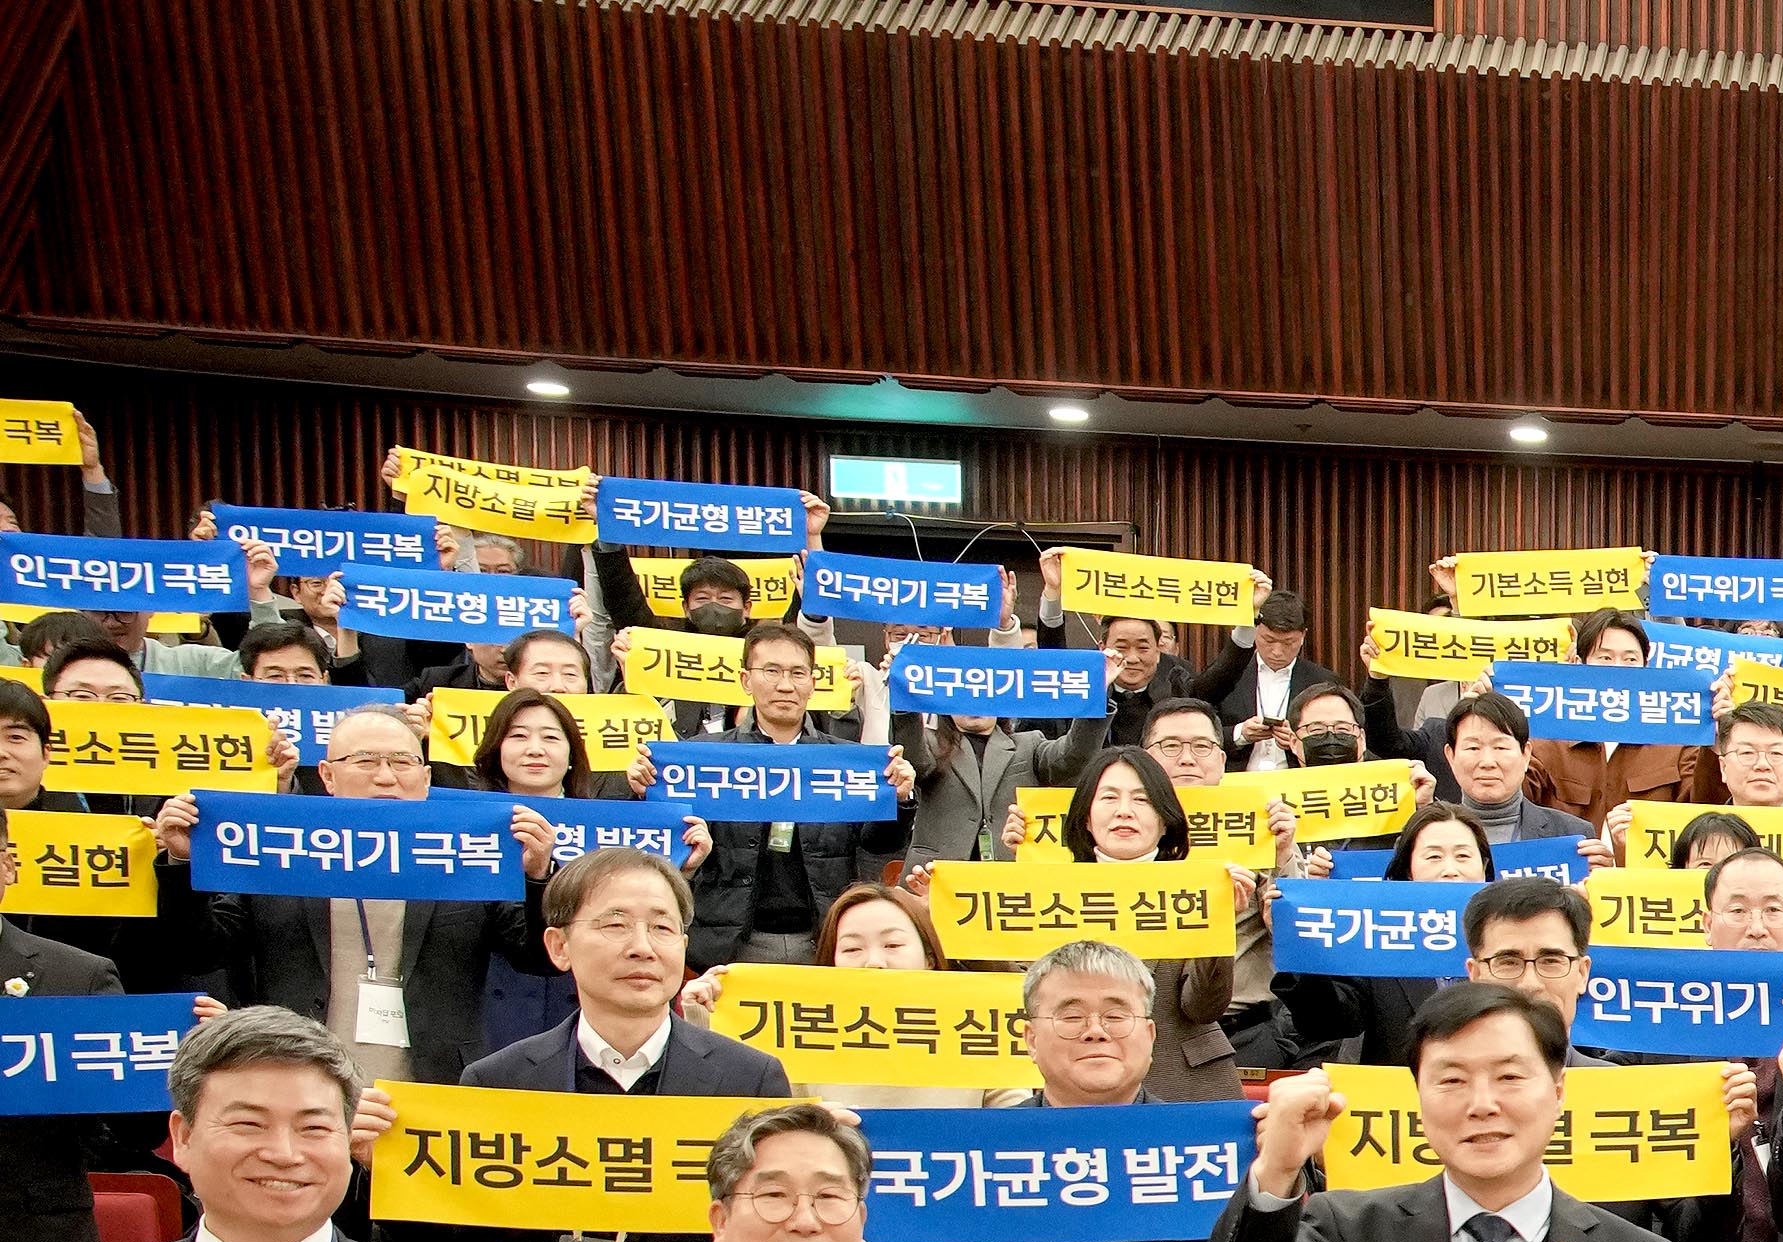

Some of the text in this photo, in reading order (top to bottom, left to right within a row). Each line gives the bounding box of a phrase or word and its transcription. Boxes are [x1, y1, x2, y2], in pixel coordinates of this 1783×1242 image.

[4, 419, 61, 447] 극복
[424, 473, 538, 523] 지방소멸
[613, 497, 793, 537] 국가균형 발전
[228, 523, 424, 563] 인구위기 극복
[10, 553, 232, 594] 인구위기 극복
[816, 568, 989, 611] 인구위기 극복
[1076, 567, 1239, 606] 기본소득 실현
[1472, 568, 1629, 599] 기본소득 실현
[1663, 573, 1765, 603] 인구위기
[356, 584, 560, 629] 국가균형 발전
[643, 646, 742, 682] 기본소
[1384, 629, 1558, 662] 기본소득 실현
[904, 663, 1091, 699] 인구위기 극복
[1503, 685, 1701, 725] 국가균형 발전
[598, 713, 664, 745] 실현
[48, 731, 254, 772] 본소득 실현
[663, 764, 879, 801] 인구위기 극복
[1339, 783, 1399, 816] 실현
[216, 821, 400, 874] 인구위기
[412, 831, 503, 874] 극복
[1189, 812, 1256, 846] 활력
[35, 844, 131, 888] 실현
[956, 889, 1209, 932] 기본소득 실현
[1295, 905, 1456, 950] 국가균형
[1589, 977, 1770, 1025] 인구위기
[738, 1001, 940, 1055] 기본소득
[71, 1031, 178, 1081] 극복
[1589, 1108, 1700, 1165] 극복
[404, 1127, 652, 1195] 지방소멸
[872, 1141, 1239, 1208] 국가균형 발전
